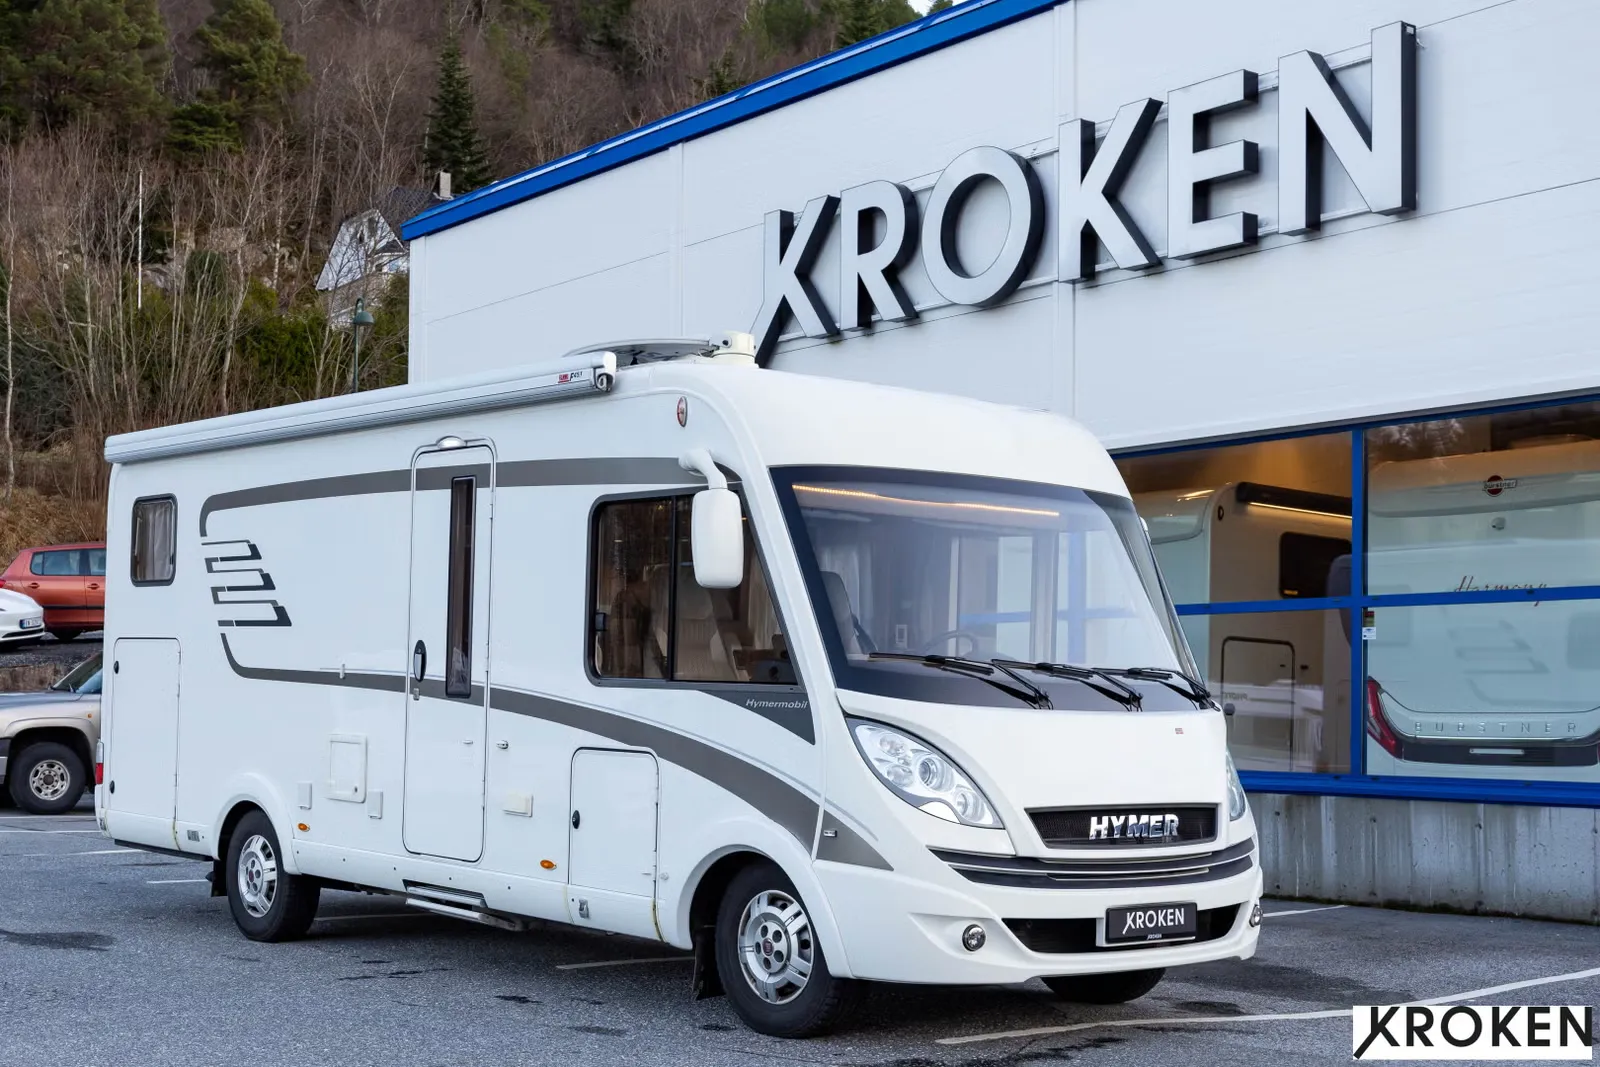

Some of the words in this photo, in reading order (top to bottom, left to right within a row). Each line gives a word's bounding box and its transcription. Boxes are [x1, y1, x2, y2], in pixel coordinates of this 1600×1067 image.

[749, 20, 1417, 368] KROKEN
[745, 698, 808, 710] Hymermobil
[1089, 814, 1180, 840] HYMER
[1122, 907, 1185, 935] KROKEN
